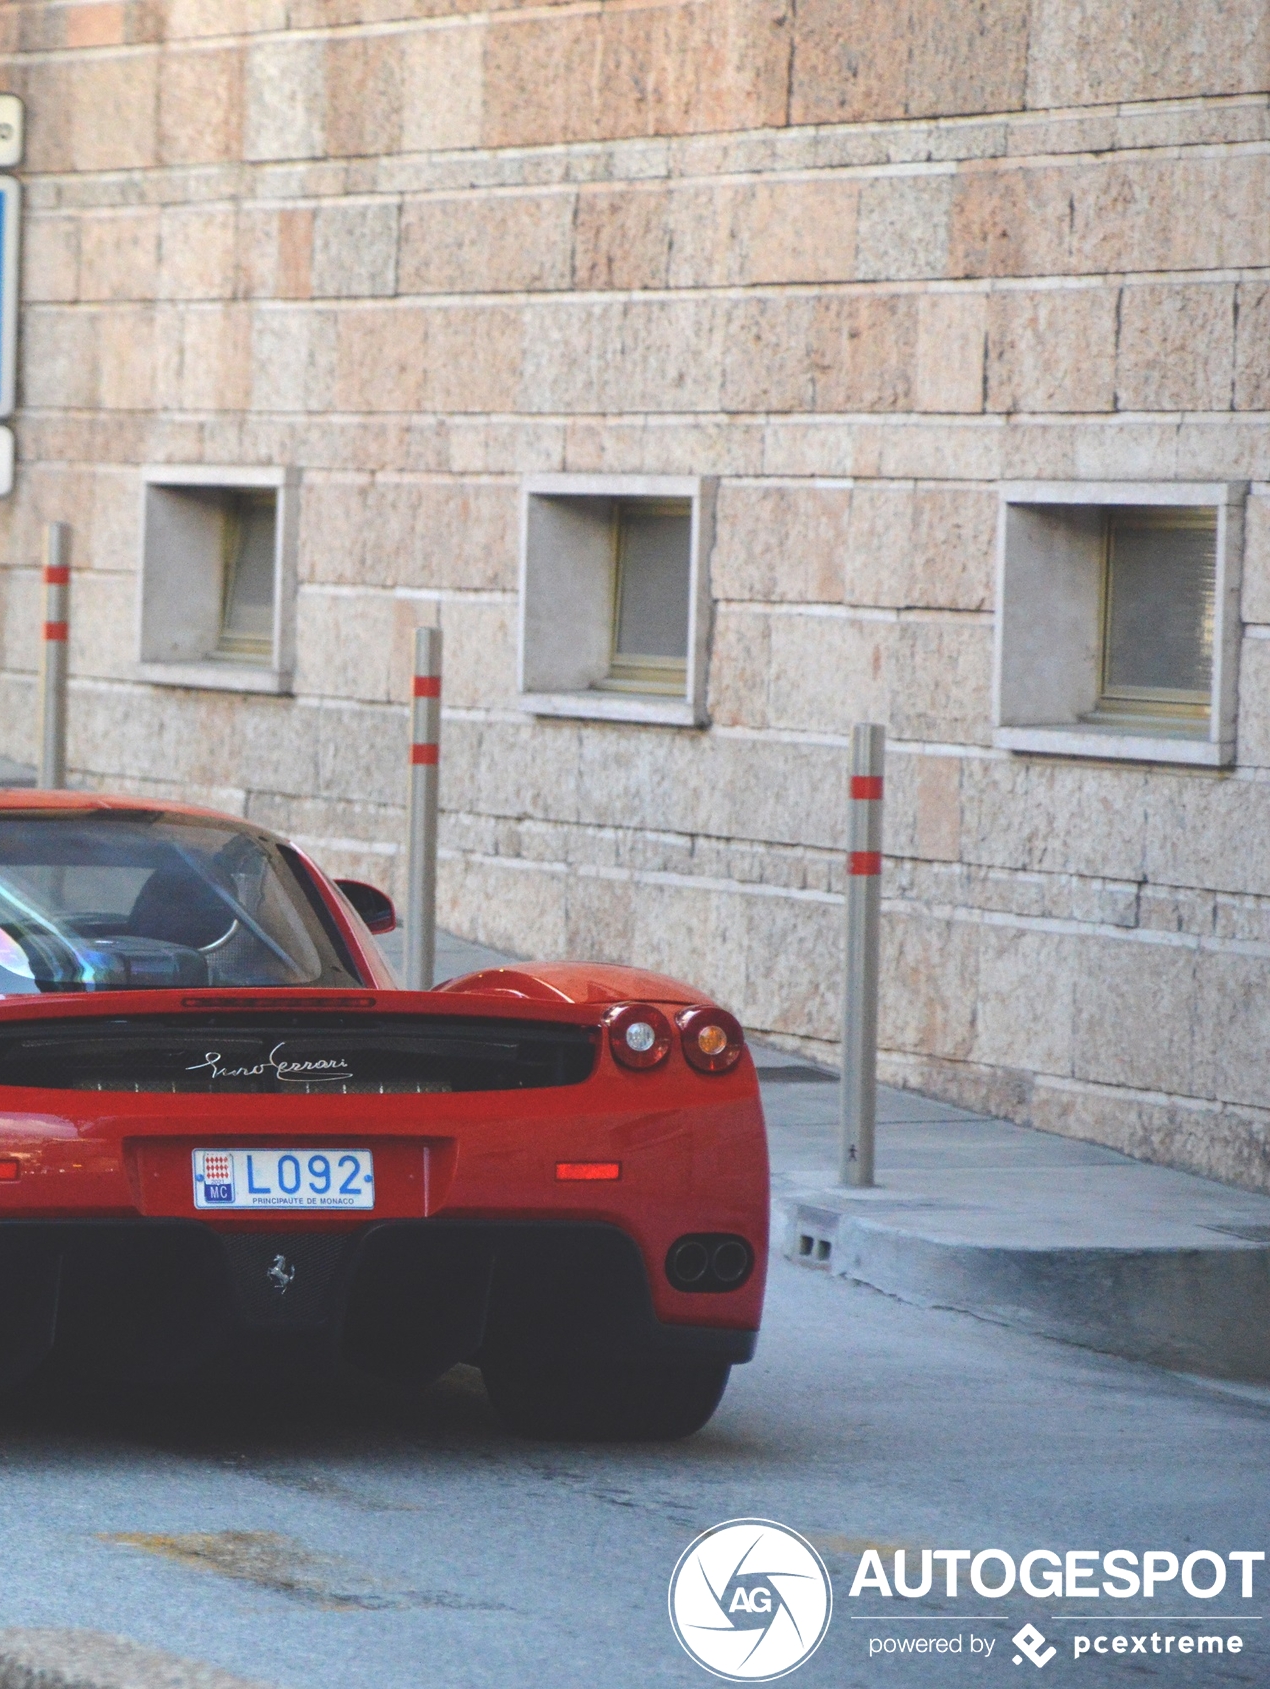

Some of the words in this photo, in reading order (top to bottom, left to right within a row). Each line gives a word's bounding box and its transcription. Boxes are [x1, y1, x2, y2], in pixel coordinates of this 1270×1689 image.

[246, 1154, 362, 1195] L092
[210, 1186, 228, 1199] MC
[252, 1197, 304, 1205] PRINCIPAUTE
[307, 1197, 317, 1205] DE
[320, 1197, 355, 1205] MONACO
